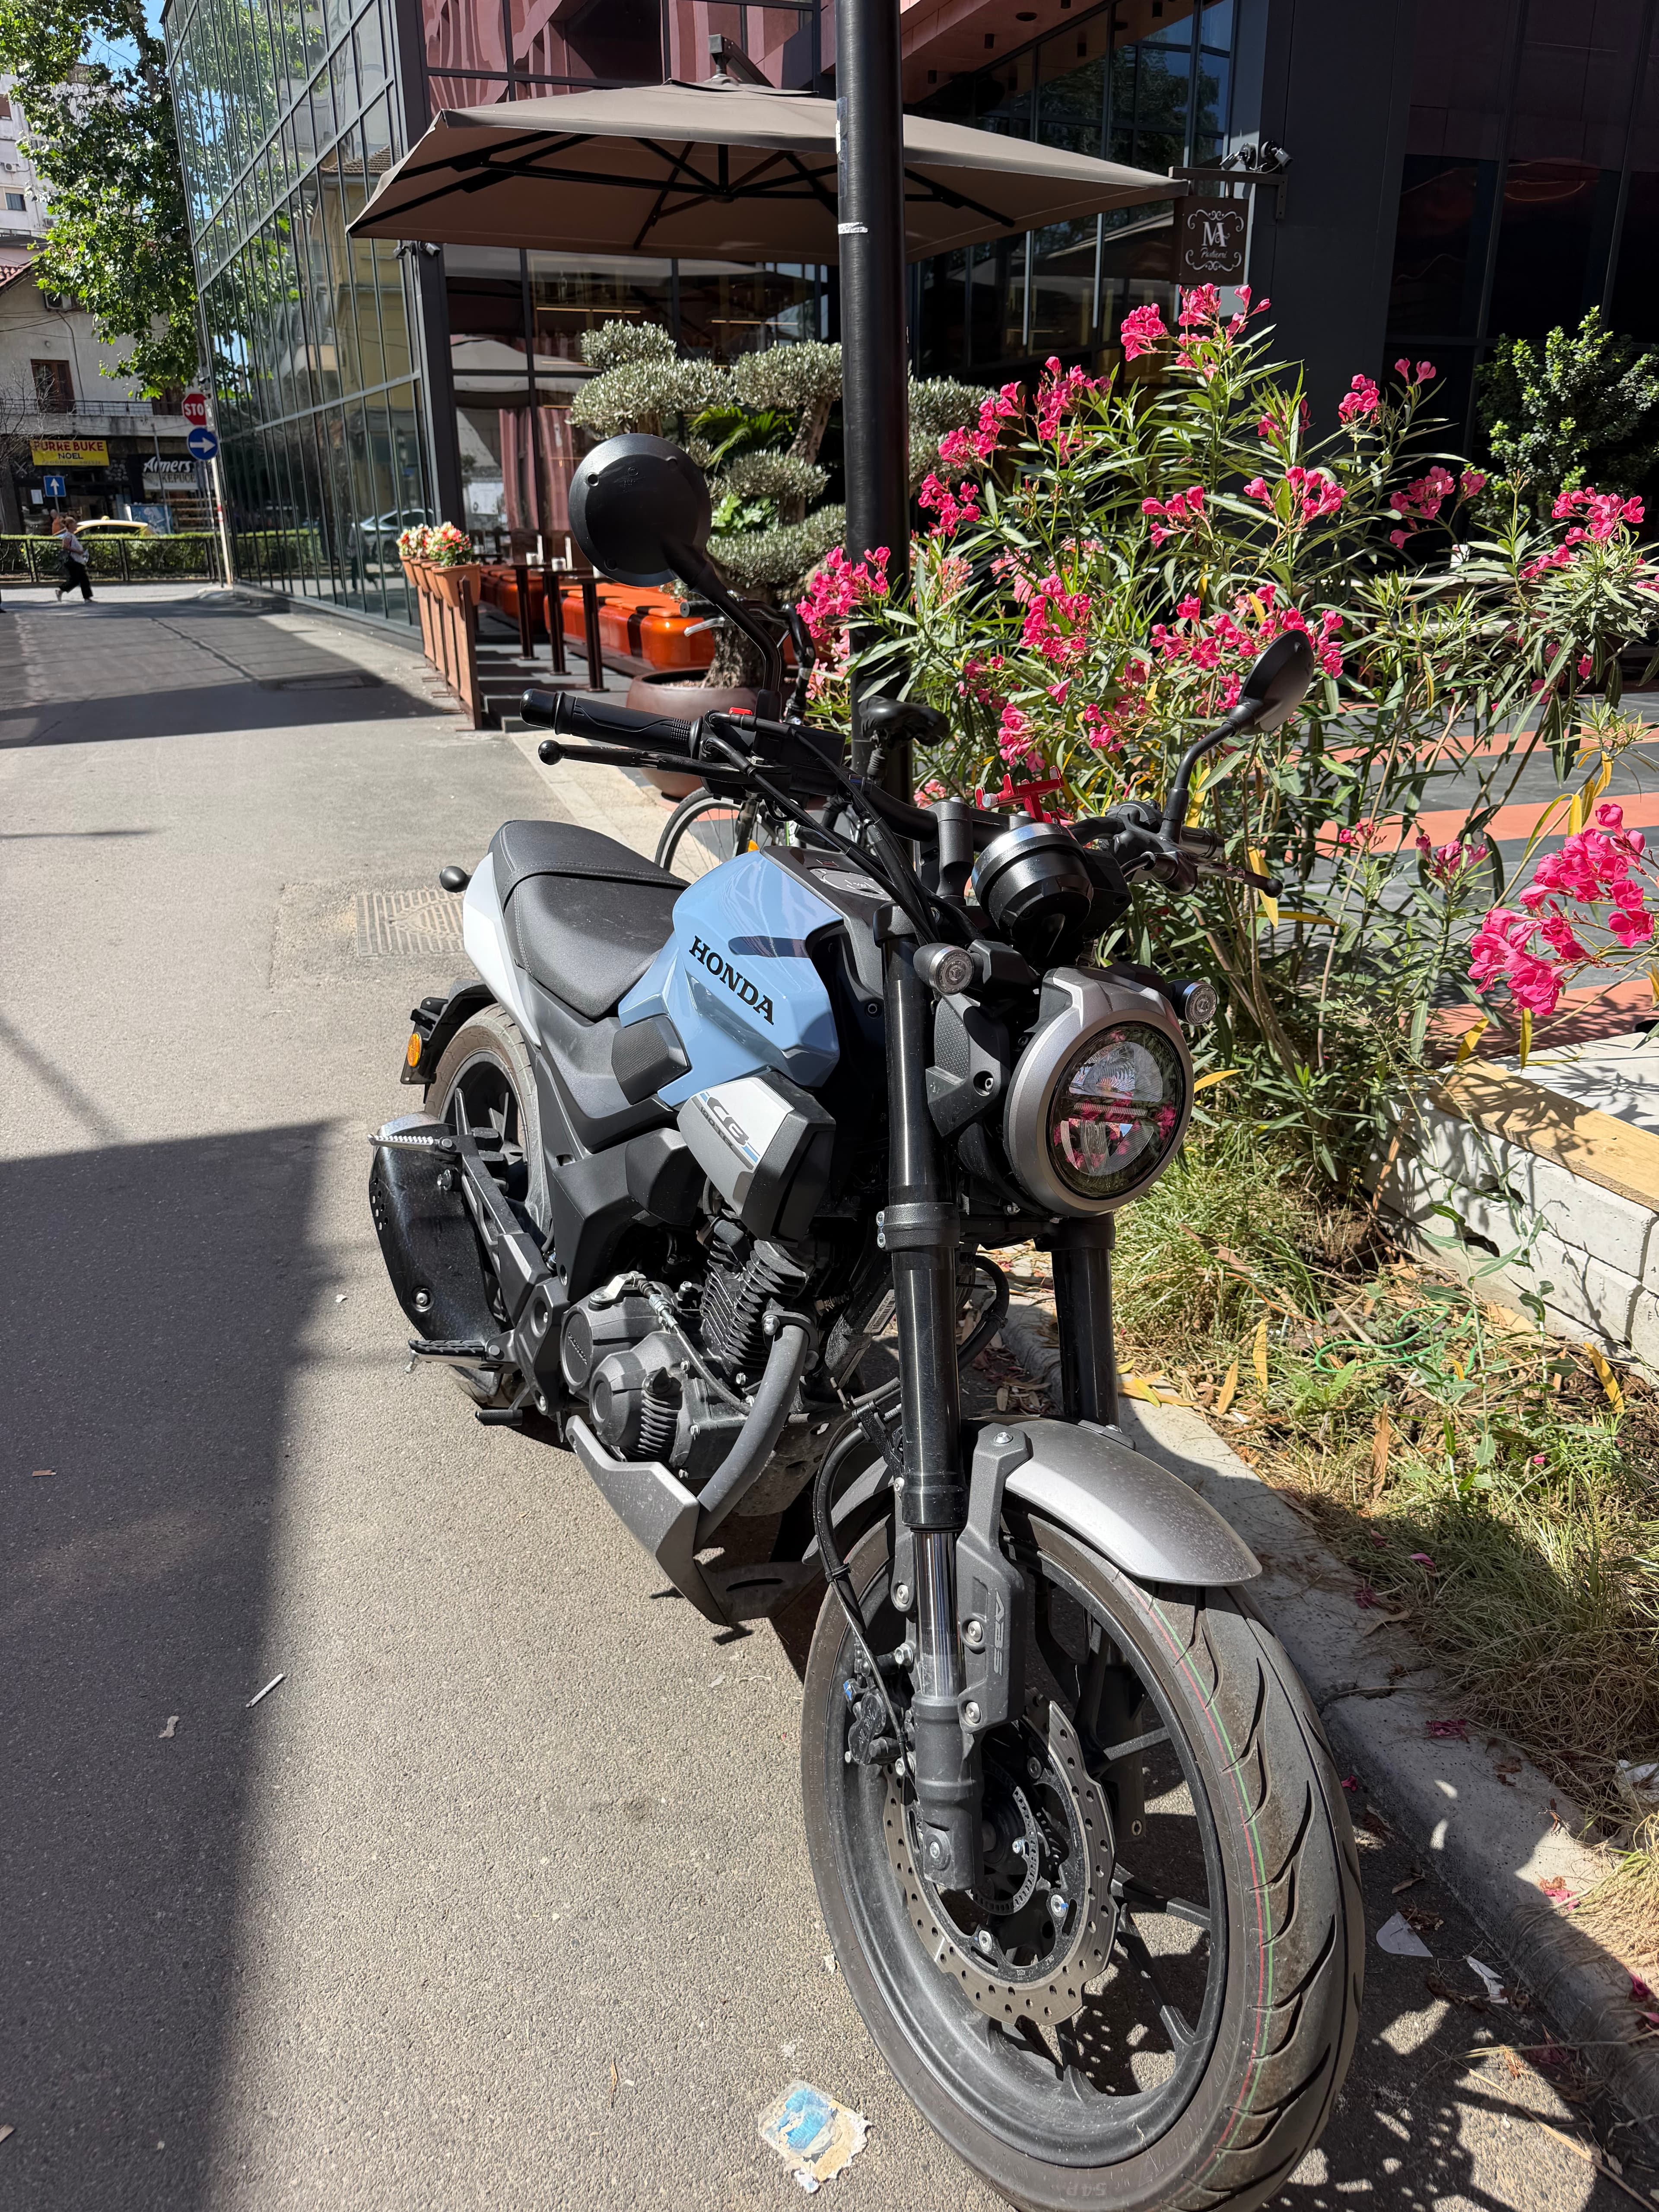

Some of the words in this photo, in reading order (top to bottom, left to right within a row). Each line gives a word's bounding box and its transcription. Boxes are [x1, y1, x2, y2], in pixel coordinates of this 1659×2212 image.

[184, 403, 204, 416] STO
[73, 442, 104, 451] BUKE
[689, 935, 774, 1026] HONDA
[994, 1590, 1005, 1677] ABS
